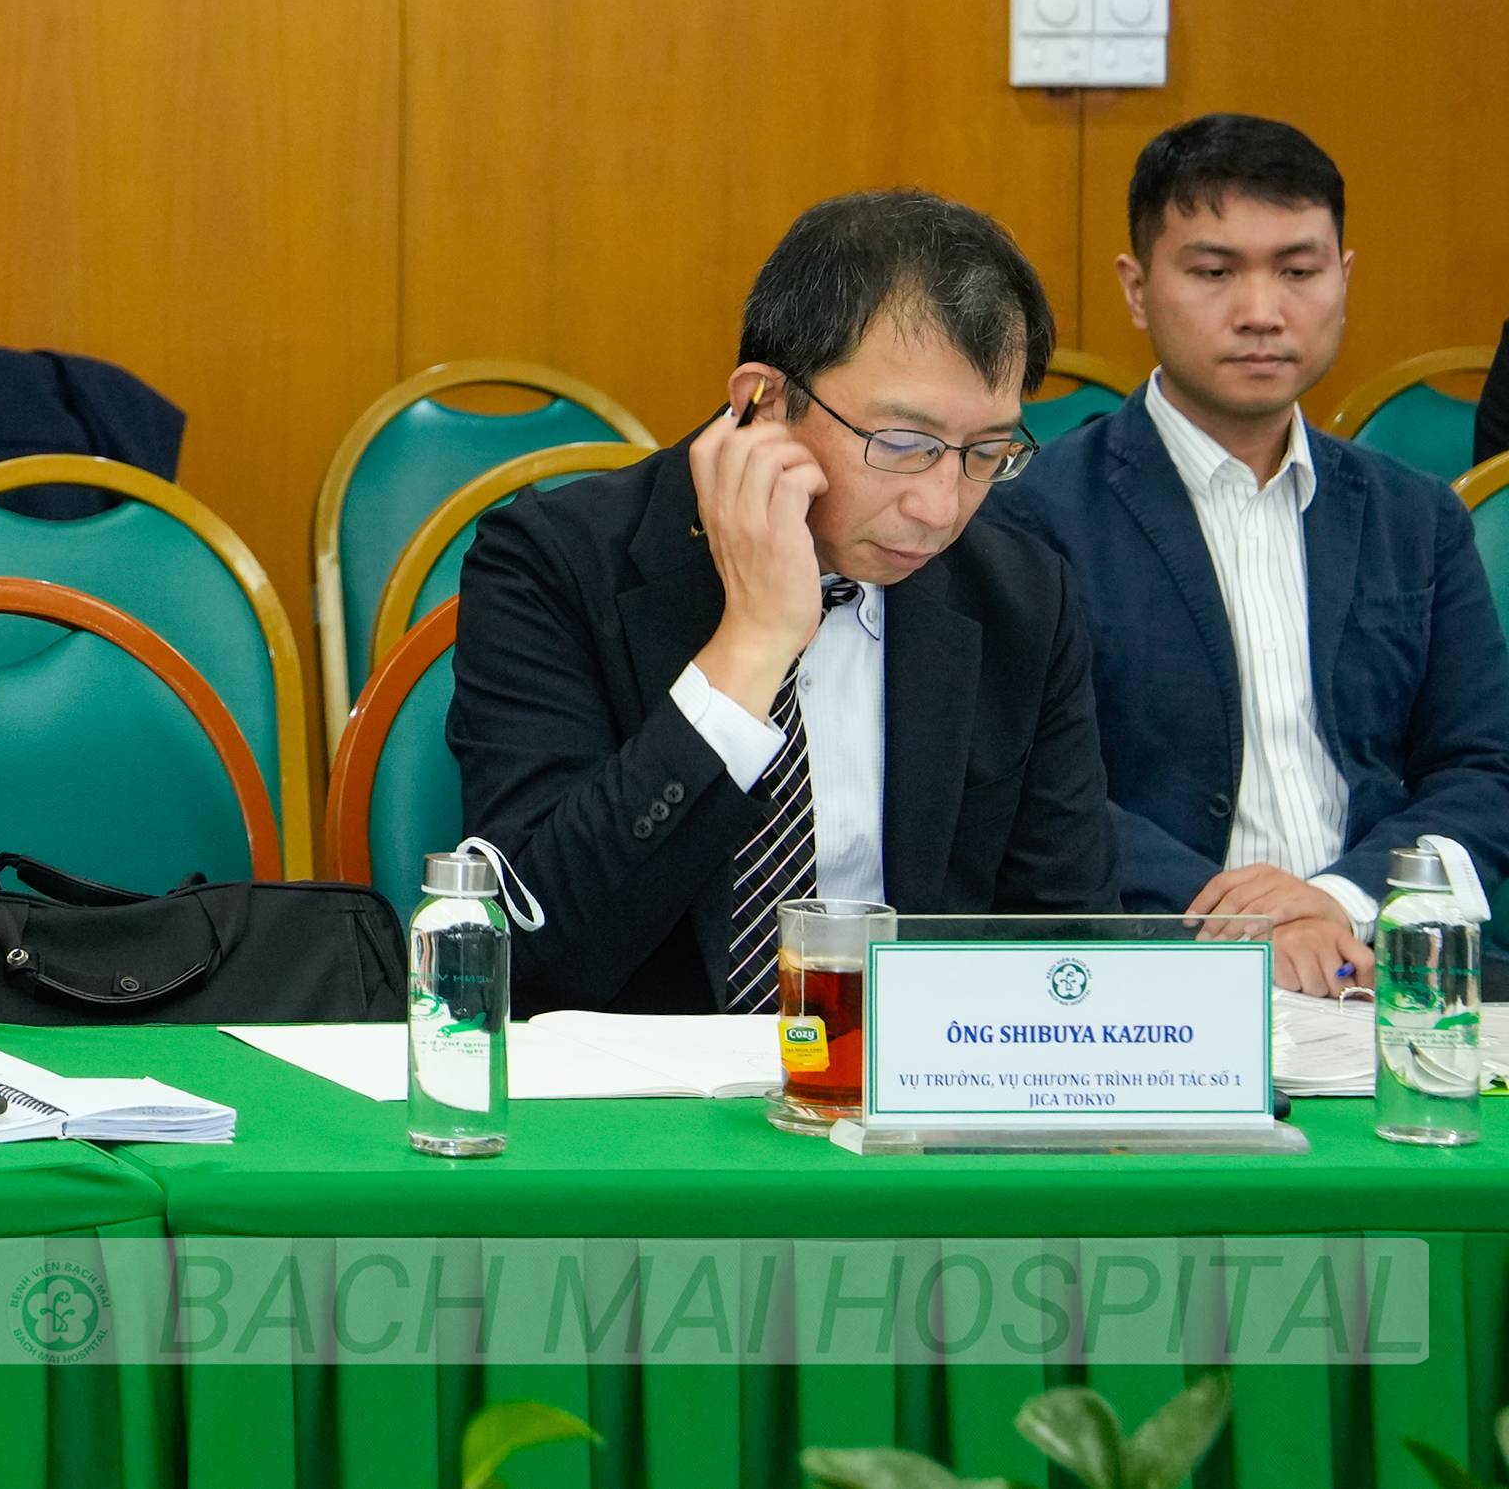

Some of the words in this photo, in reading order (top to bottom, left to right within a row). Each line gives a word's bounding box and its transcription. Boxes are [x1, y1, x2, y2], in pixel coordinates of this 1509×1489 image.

[789, 1029, 815, 1041] Cozy
[947, 1021, 994, 1044] ÔNG
[1000, 1024, 1097, 1044] SHIBUYA
[1101, 1024, 1194, 1044] KAZURO
[898, 1074, 919, 1089] VỤ
[924, 1071, 995, 1088] TRƯỞNG,
[998, 1074, 1019, 1089] VỤ
[1023, 1073, 1090, 1087] CHƯƠNG
[1094, 1071, 1143, 1087] TRÌNH
[1147, 1070, 1174, 1087] ĐỐI
[1178, 1071, 1207, 1087] TÁC
[1210, 1070, 1229, 1087] SỐ
[1235, 1074, 1241, 1087] 1
[1029, 1093, 1060, 1109] JICA
[1063, 1093, 1115, 1106] TOKYO
